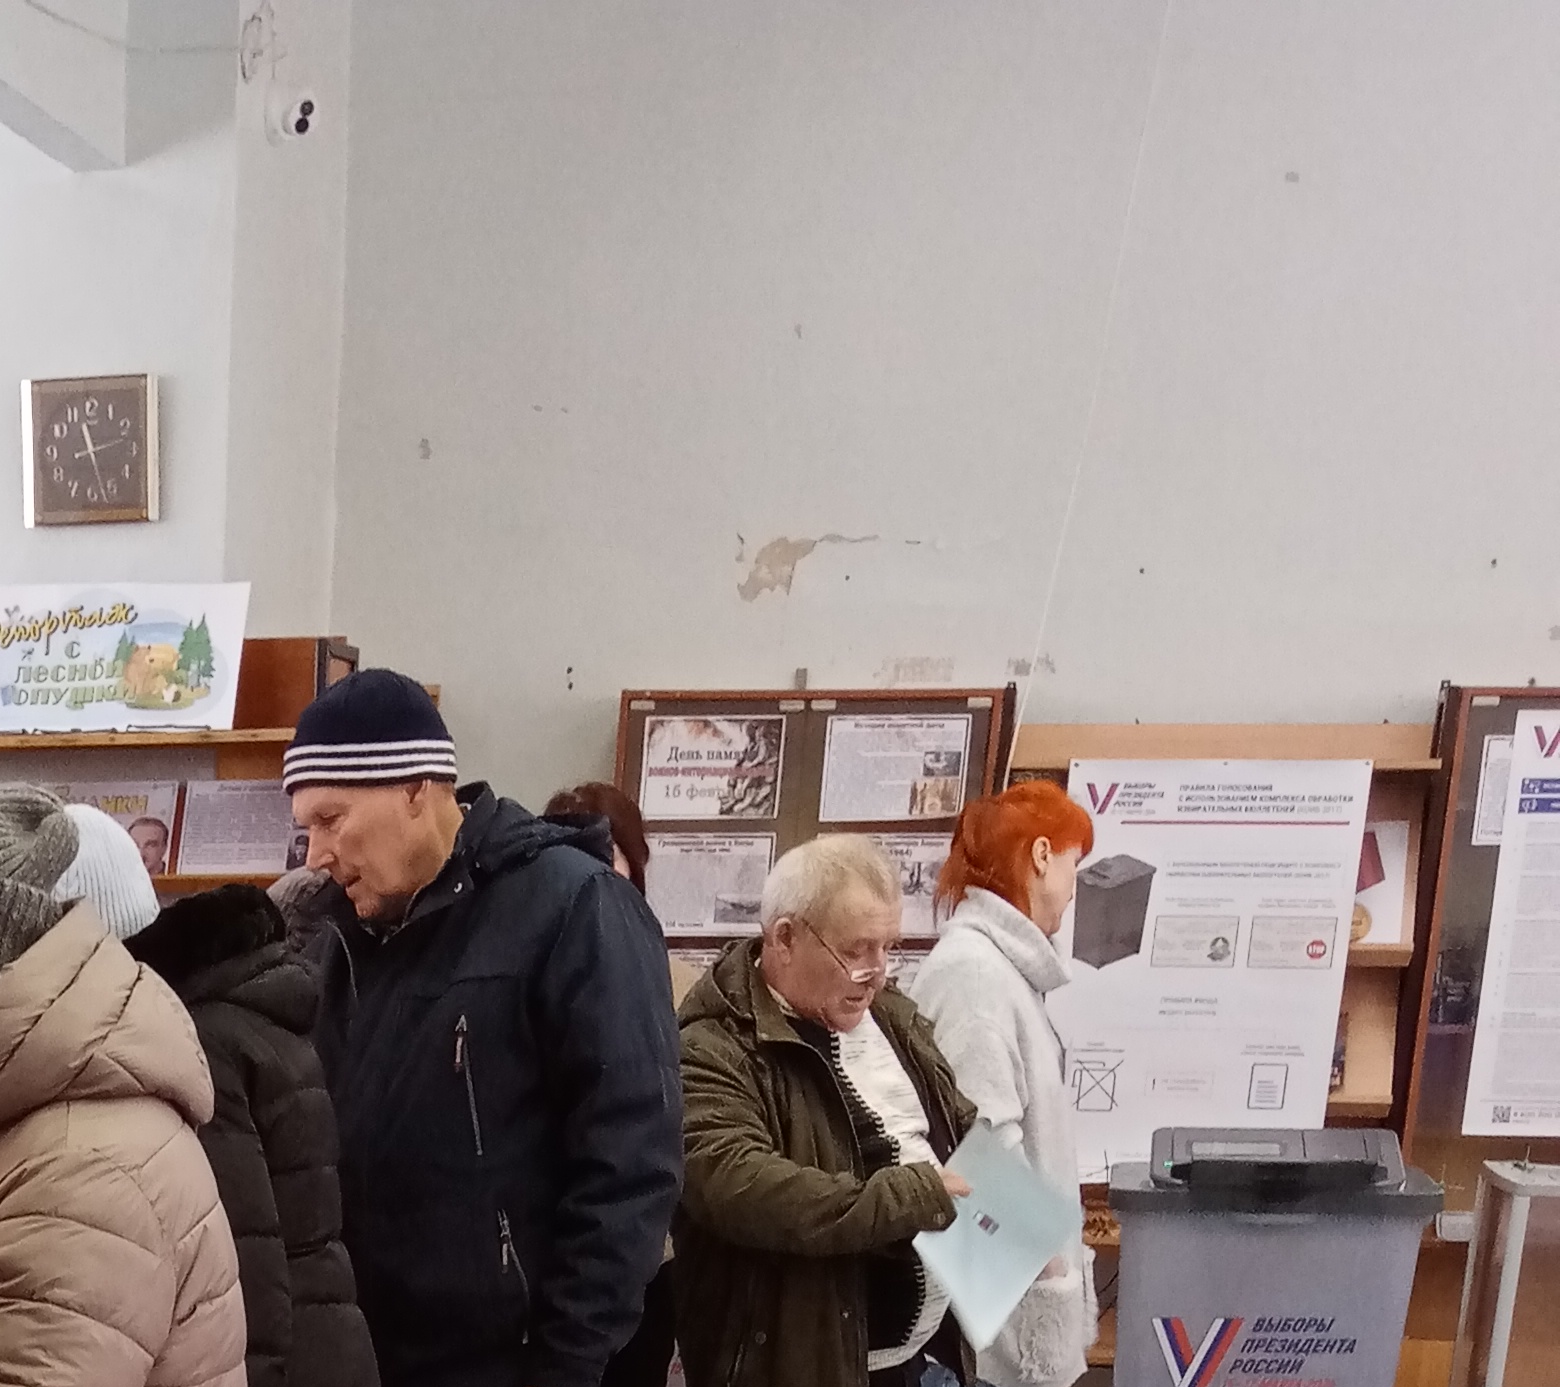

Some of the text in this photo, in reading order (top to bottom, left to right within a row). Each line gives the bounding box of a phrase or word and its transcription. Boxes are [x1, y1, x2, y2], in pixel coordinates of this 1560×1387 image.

[667, 746, 703, 763] День
[1252, 1316, 1335, 1333] ВЫБОРЫ
[1240, 1338, 1358, 1356] ПРЕЗИДЕНТА
[1229, 1359, 1305, 1374] РОССИИ
